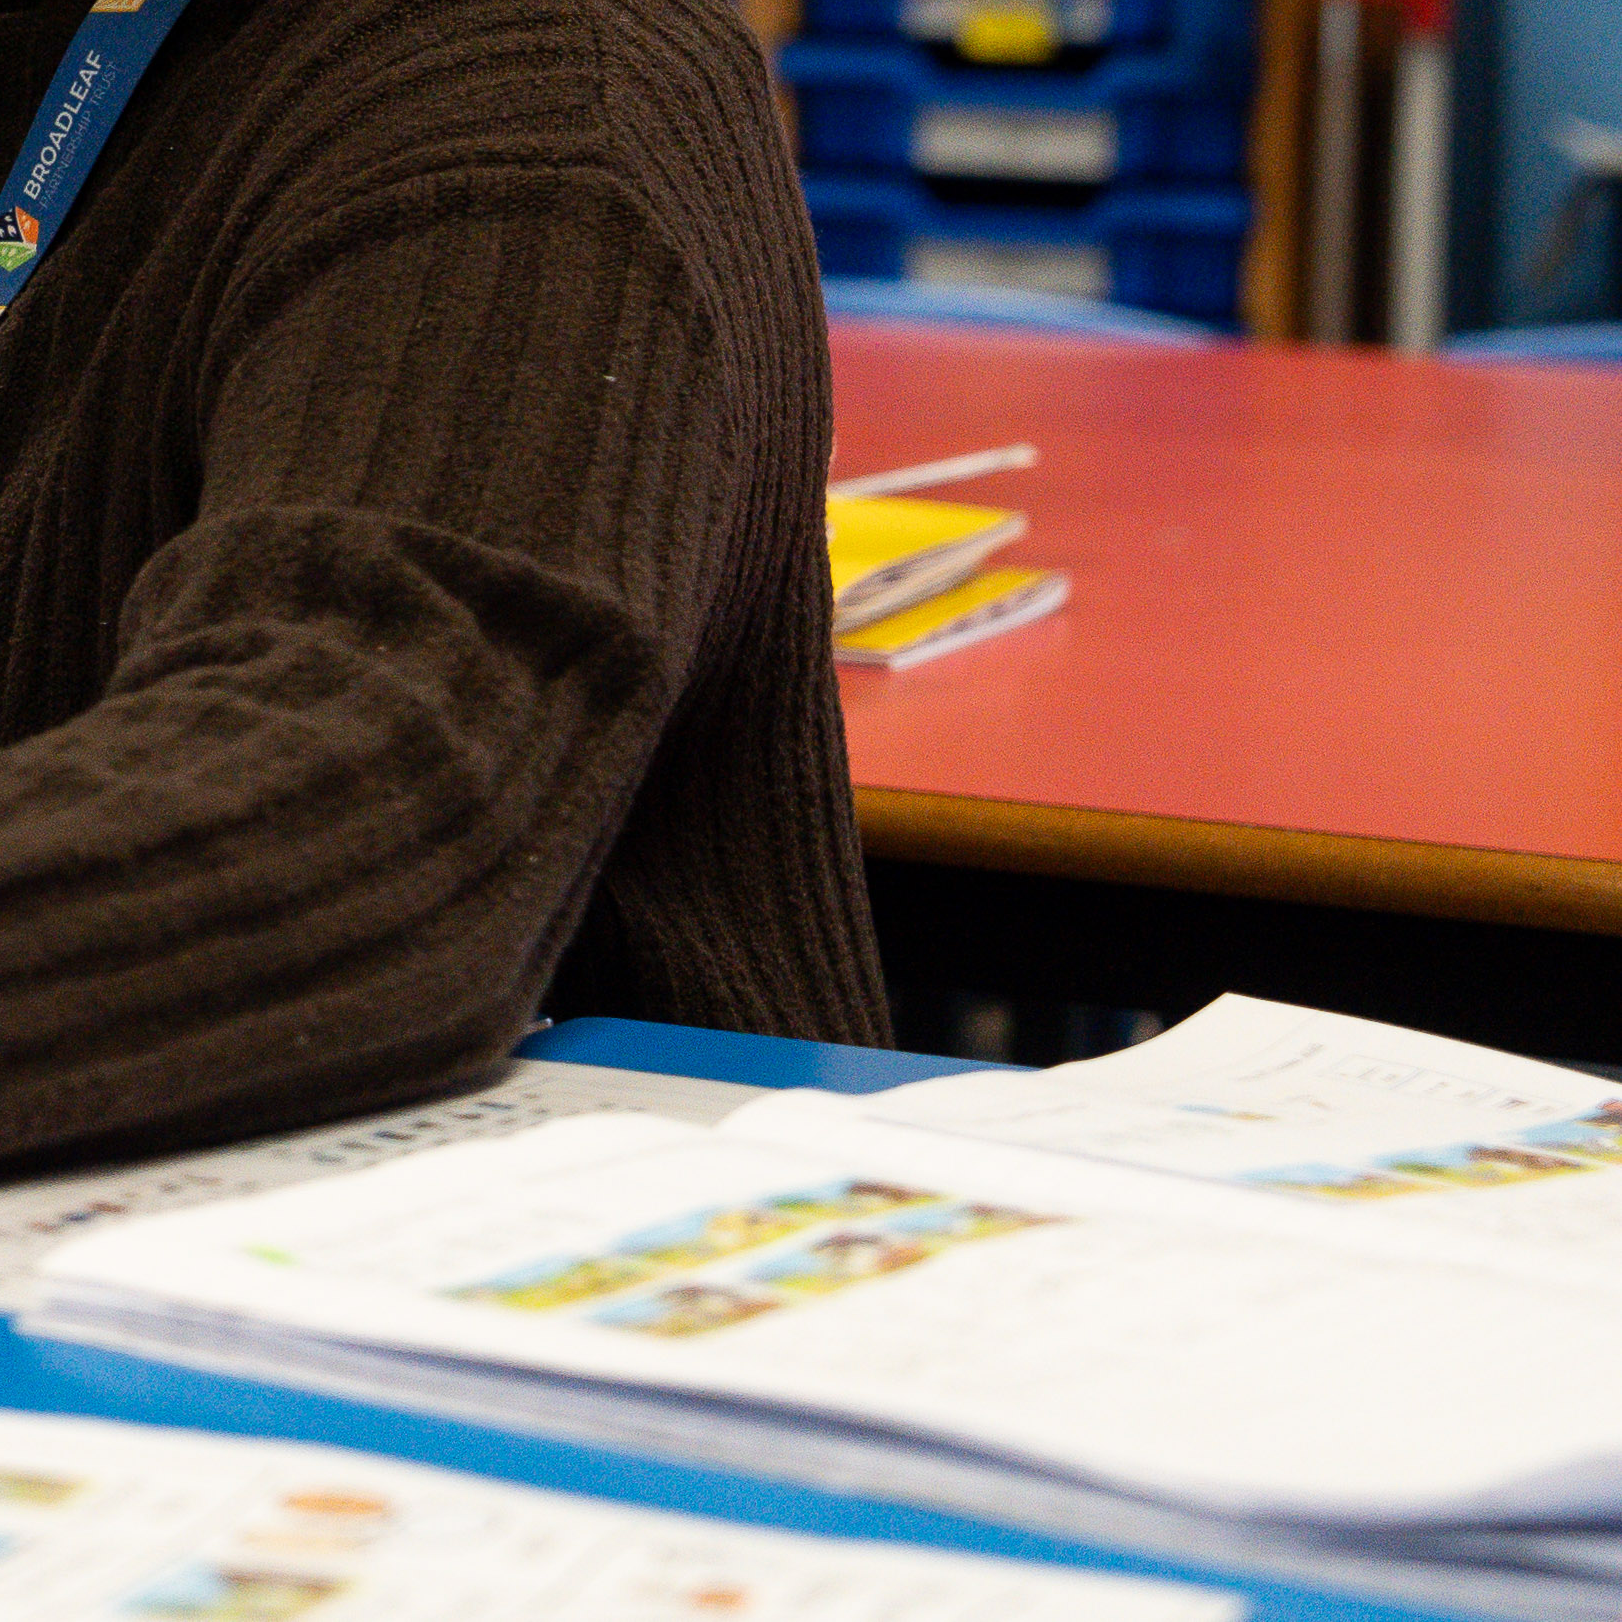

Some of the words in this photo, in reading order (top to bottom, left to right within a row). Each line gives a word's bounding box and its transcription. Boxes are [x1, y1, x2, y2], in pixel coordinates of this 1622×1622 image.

[23, 49, 102, 201] BROADLEAF
[39, 109, 92, 210] PARTNERSHIP
[90, 60, 118, 107] TRUST
